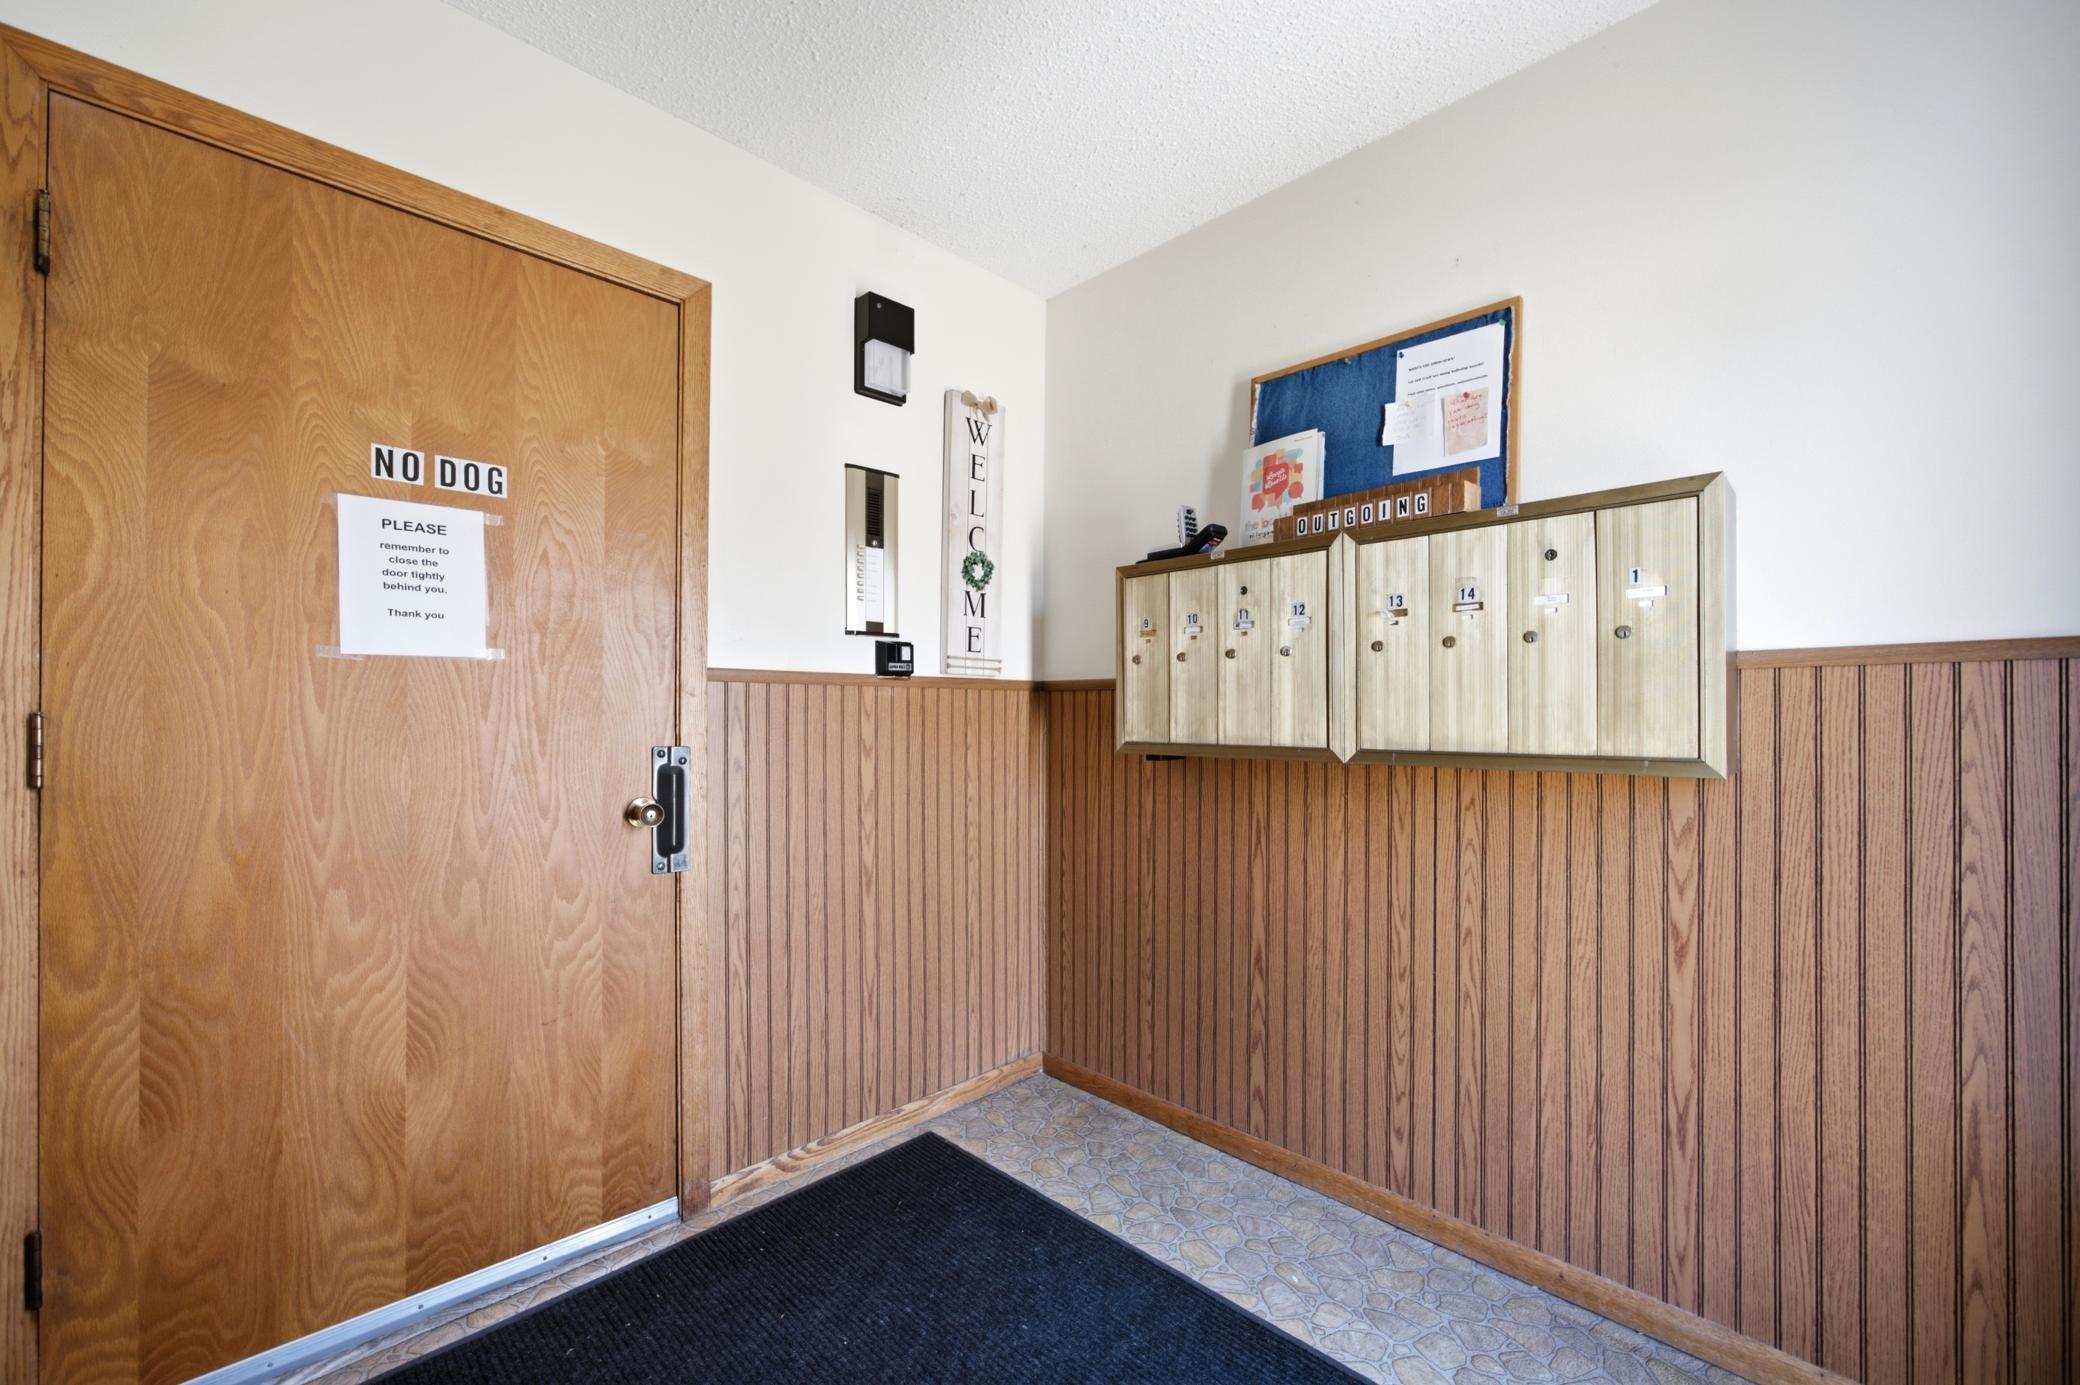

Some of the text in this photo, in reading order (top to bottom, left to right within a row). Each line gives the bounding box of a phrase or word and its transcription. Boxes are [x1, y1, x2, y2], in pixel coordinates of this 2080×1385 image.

[375, 447, 503, 495] NO DOG
[1298, 496, 1426, 534] OUTGOING
[381, 518, 447, 536] PLEASE
[379, 542, 450, 555] remember to
[388, 556, 439, 567] close the
[382, 568, 445, 582] door tightly
[1631, 568, 1639, 583] 1
[383, 581, 448, 594] behind you.
[1460, 587, 1475, 600] 14
[1389, 595, 1403, 607] 13
[387, 608, 445, 620] Thank you
[1293, 604, 1305, 616] 12
[1143, 618, 1149, 628] 9
[1187, 613, 1198, 624] 10
